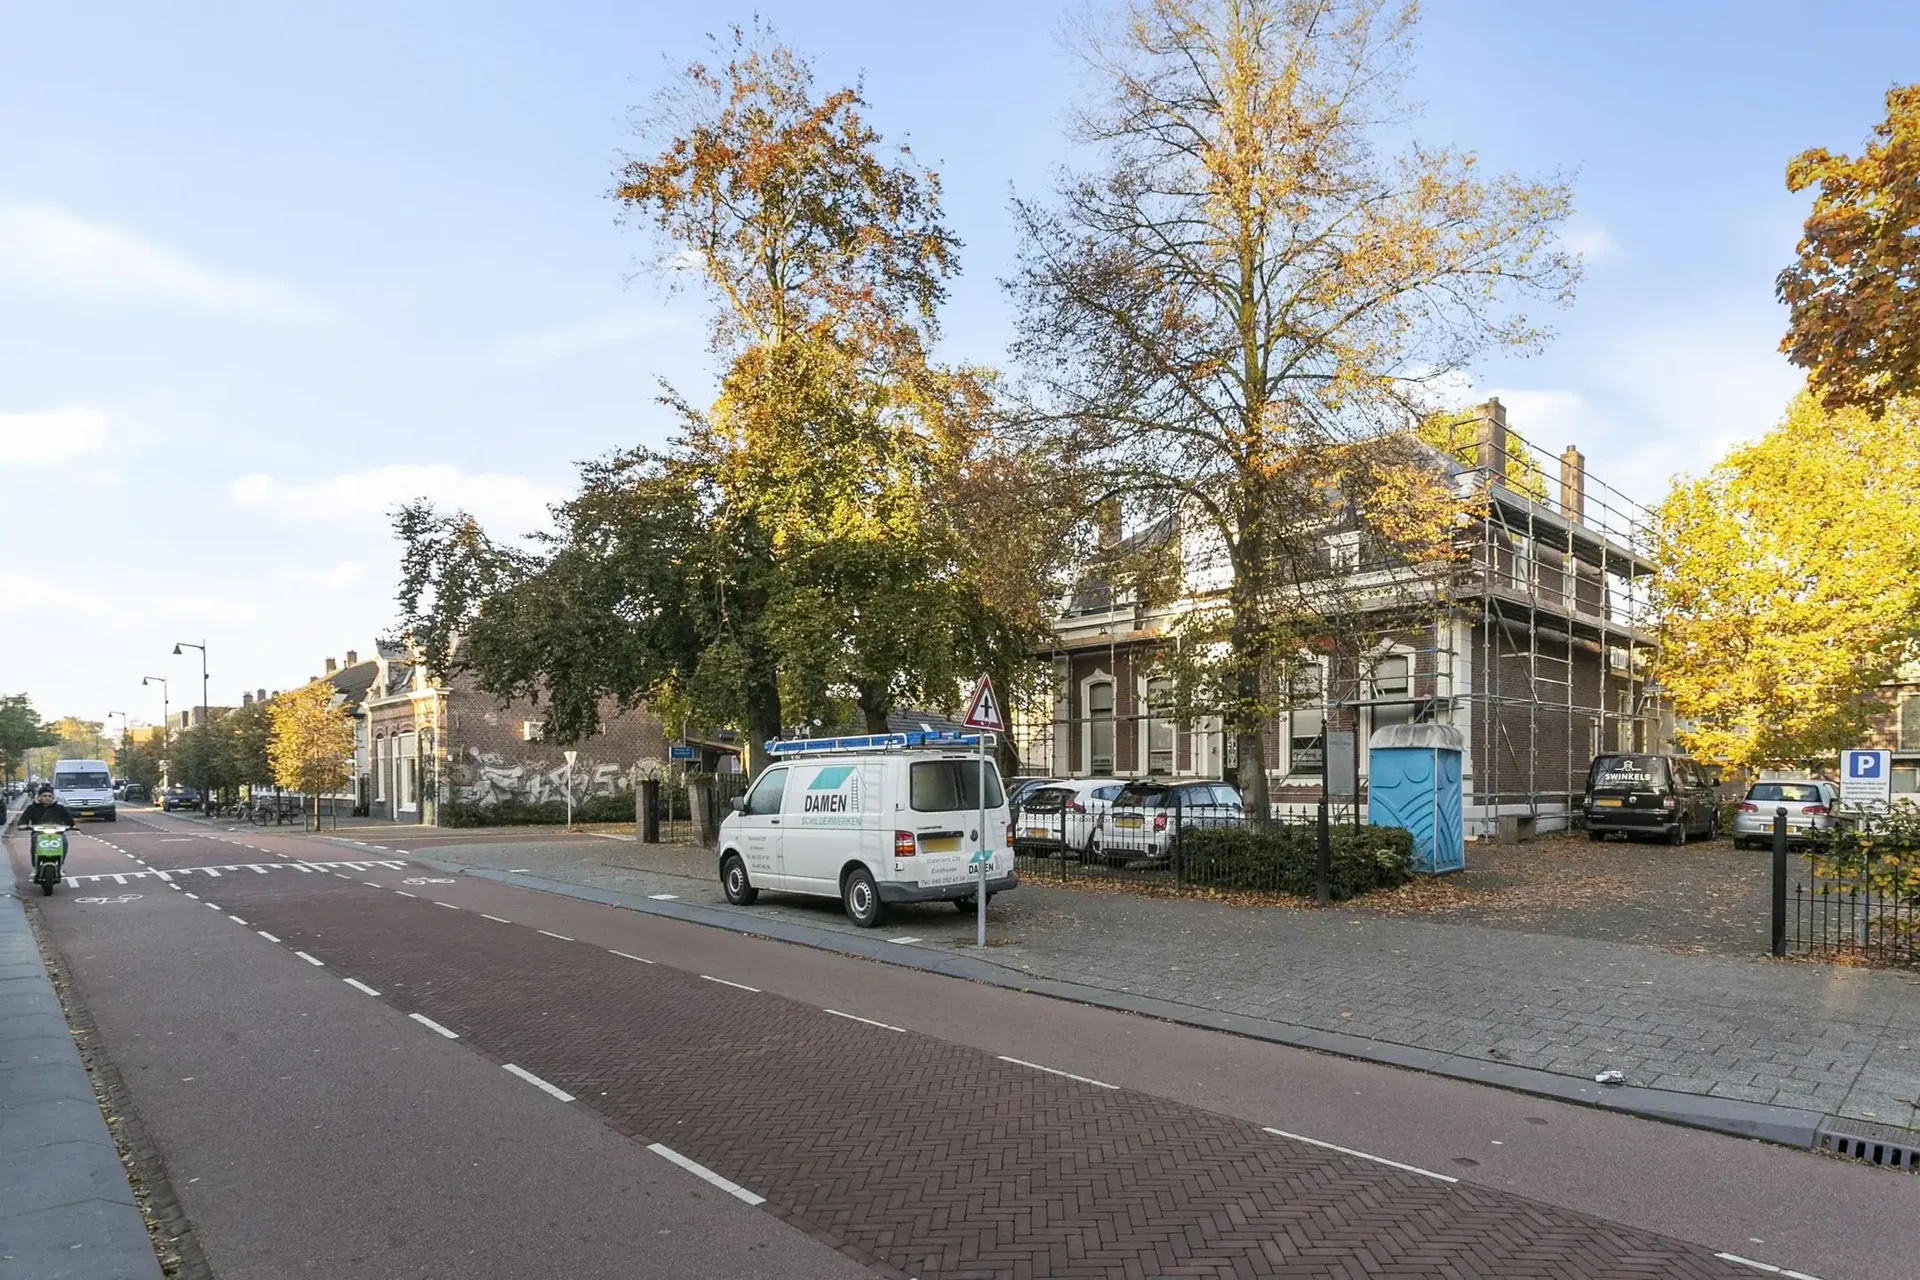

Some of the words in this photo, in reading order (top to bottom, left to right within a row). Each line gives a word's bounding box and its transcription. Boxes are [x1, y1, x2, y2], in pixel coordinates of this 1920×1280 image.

[1857, 755, 1876, 776] P
[1604, 773, 1652, 781] SWINKELS
[804, 794, 847, 813] DAMEN
[801, 817, 861, 826] SCHILDERWERKEN
[39, 840, 60, 848] GO
[931, 867, 957, 875] Eindhoven
[968, 862, 995, 875] DAEN
